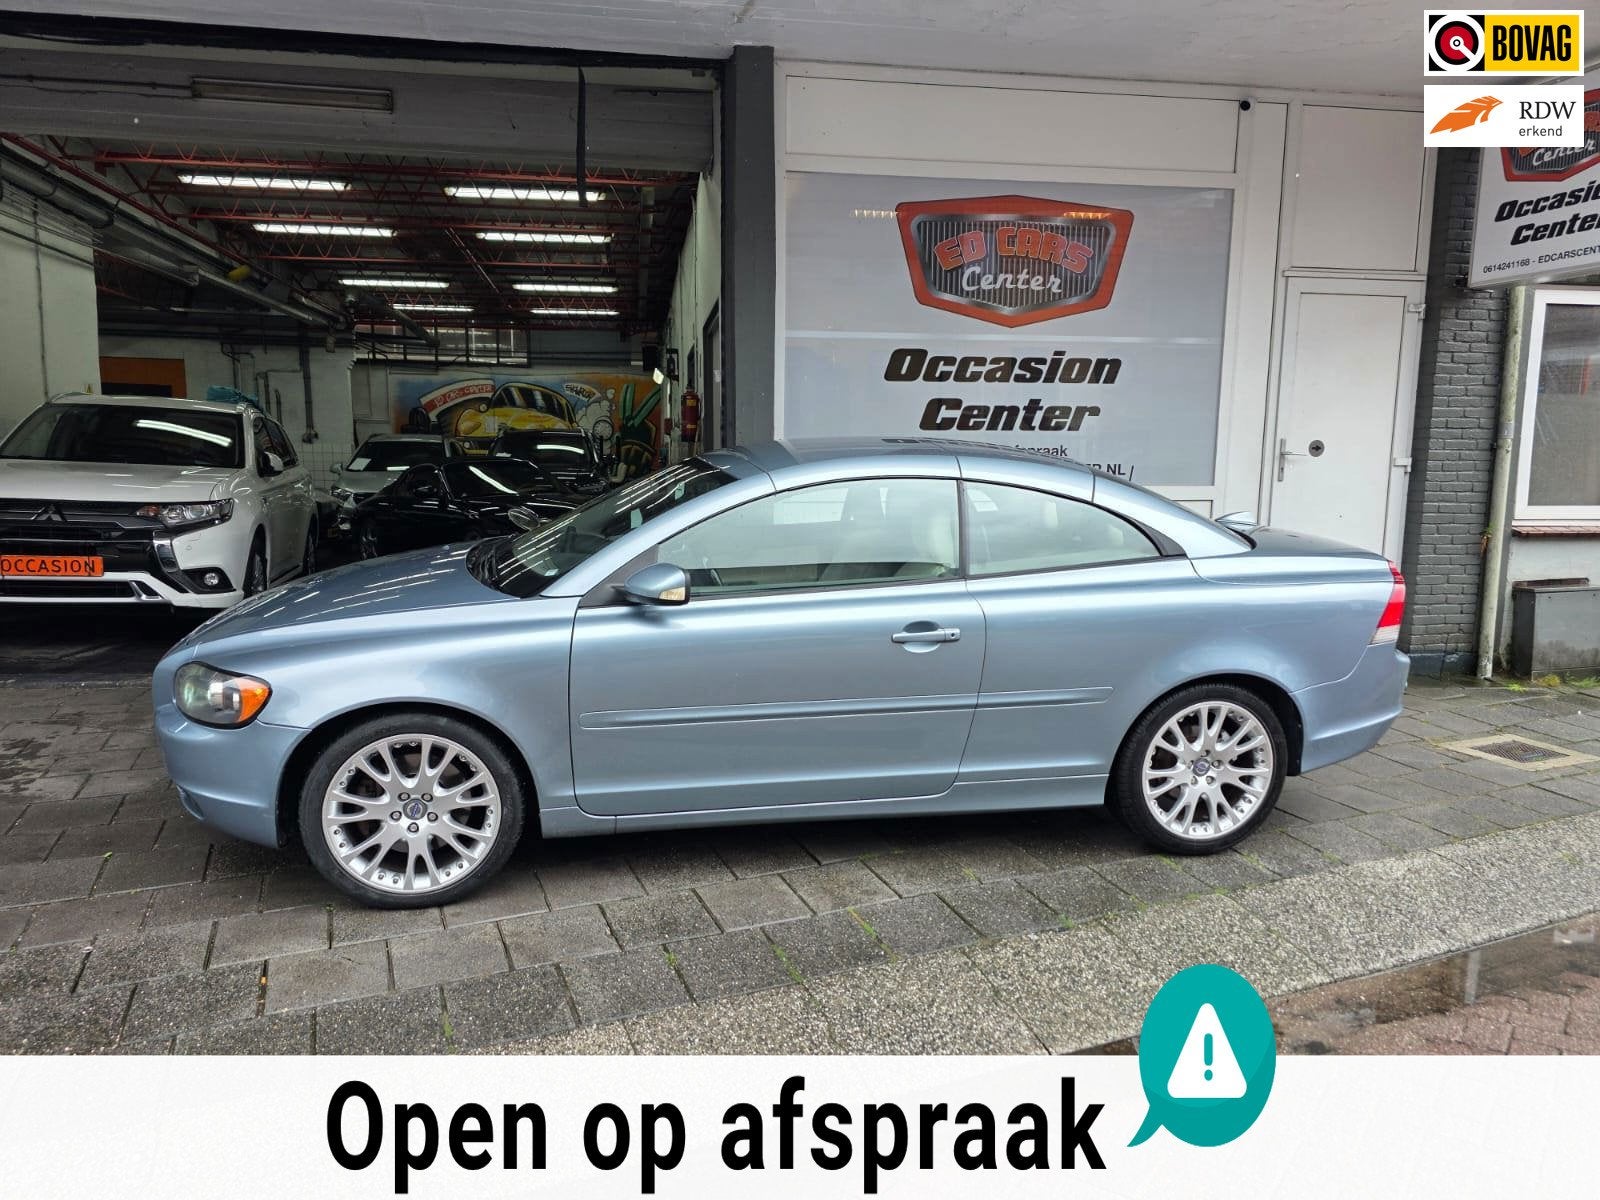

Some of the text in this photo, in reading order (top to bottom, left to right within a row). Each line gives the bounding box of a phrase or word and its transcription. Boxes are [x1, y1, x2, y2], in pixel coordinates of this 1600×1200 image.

[935, 226, 1093, 274] ED CARS
[962, 266, 1062, 293] Center
[884, 348, 1121, 385] Occasion
[919, 397, 1100, 432] Center
[1, 558, 95, 573] OCCASION
